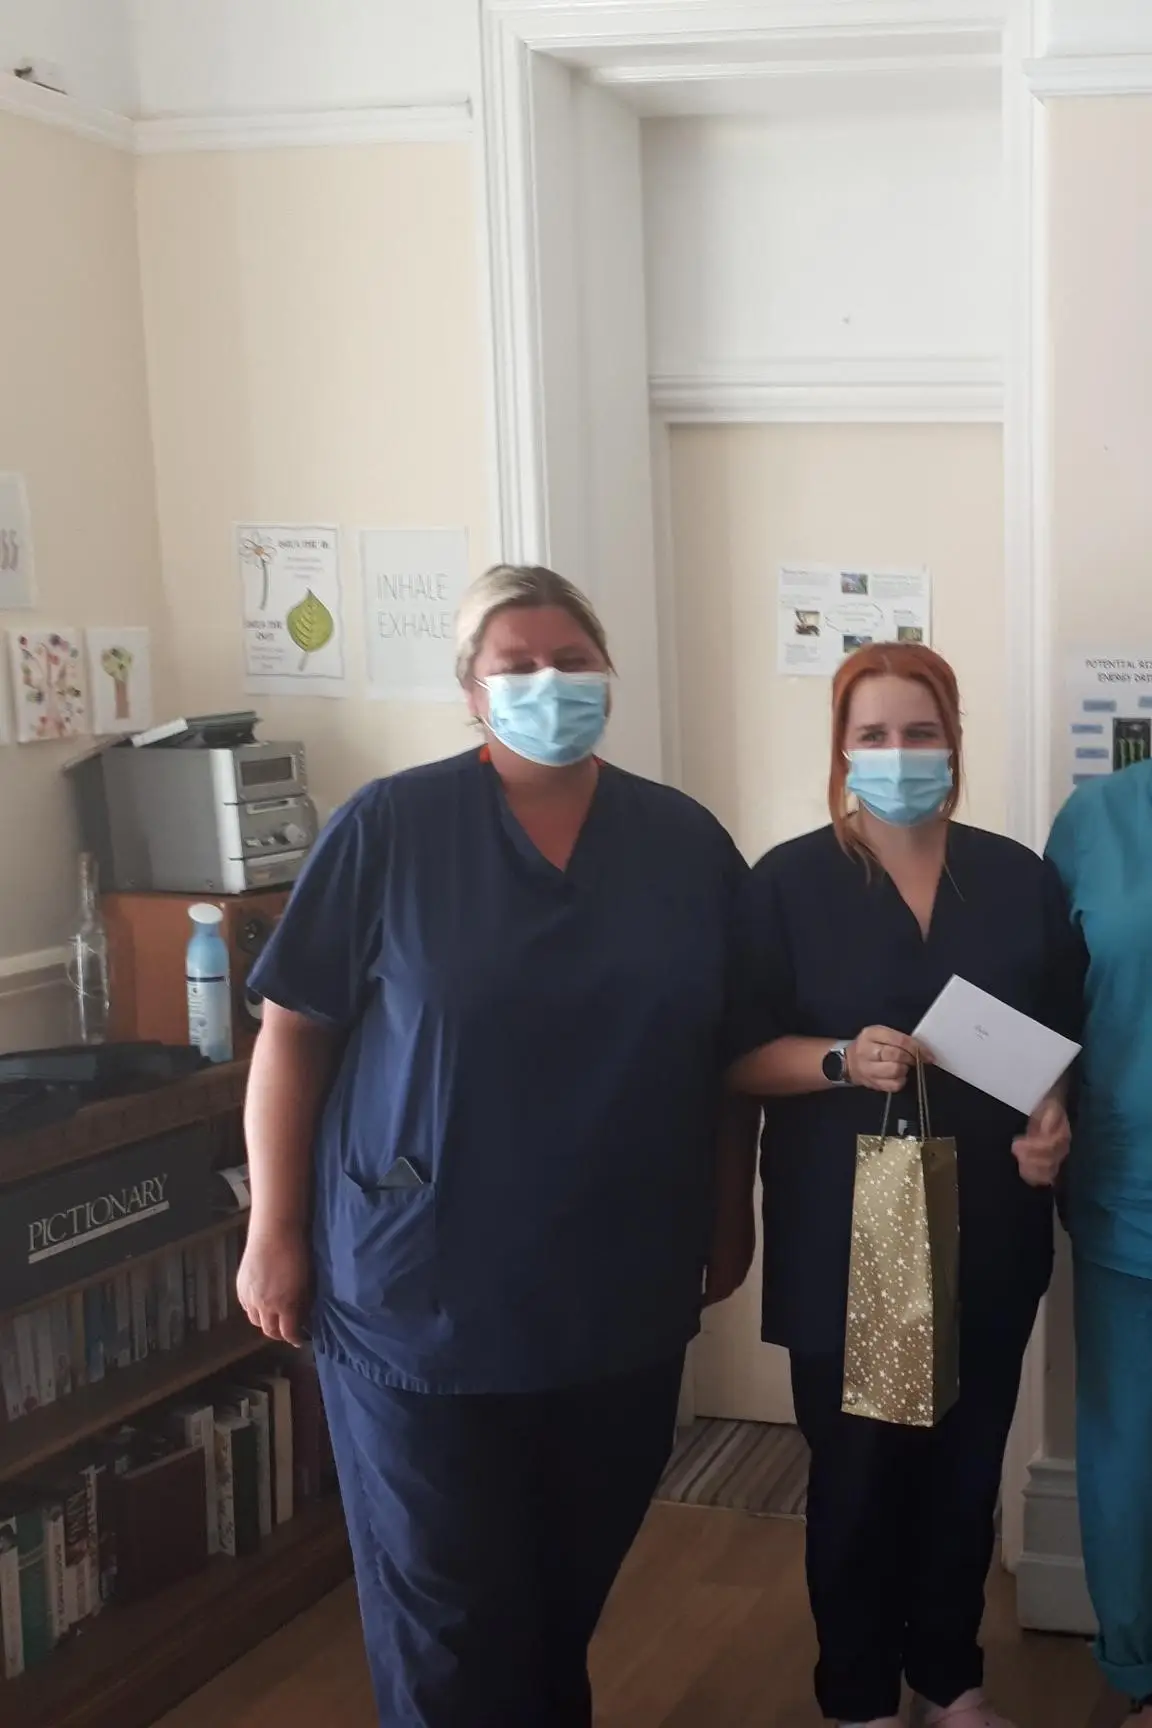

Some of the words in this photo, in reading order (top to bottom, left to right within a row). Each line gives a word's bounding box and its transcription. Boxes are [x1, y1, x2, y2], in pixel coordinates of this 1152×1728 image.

[377, 573, 449, 601] INHALE
[378, 609, 455, 639] EXHALE
[1085, 659, 1136, 670] POTENTIAL
[1097, 671, 1131, 683] ENERGY
[28, 1173, 169, 1251] PICTIONARY
